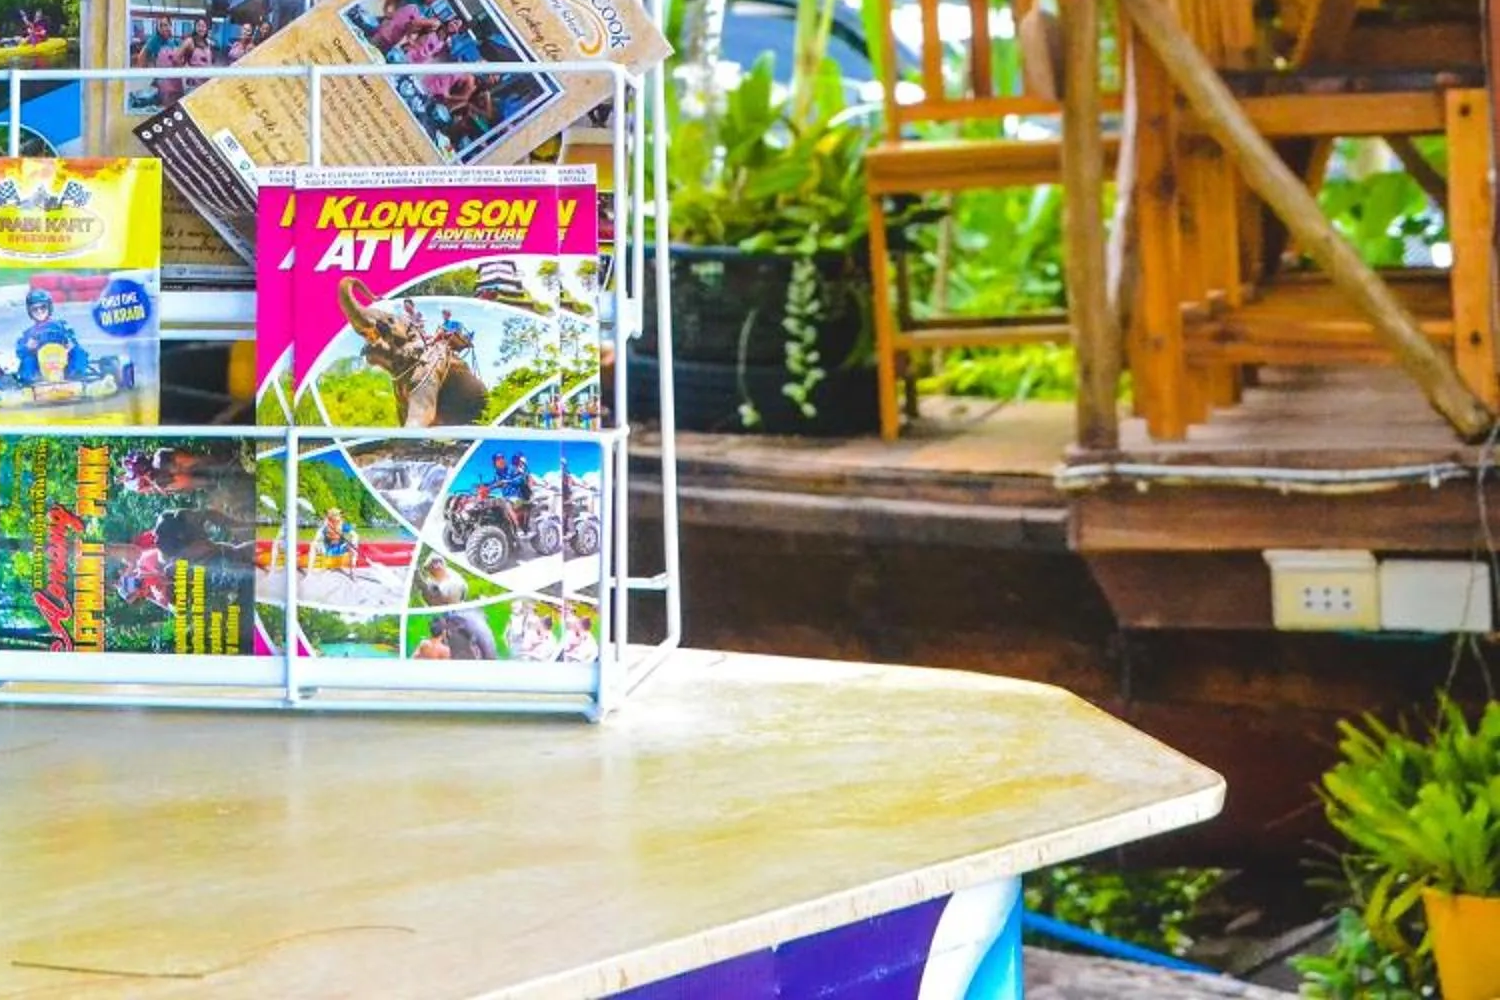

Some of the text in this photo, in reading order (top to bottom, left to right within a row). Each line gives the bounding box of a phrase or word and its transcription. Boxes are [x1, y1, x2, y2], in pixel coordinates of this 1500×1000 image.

[45, 217, 95, 233] KART
[316, 195, 538, 229] KLONG SON
[313, 228, 431, 273] ATV
[433, 227, 529, 241] ADVENTURE
[75, 446, 110, 653] LEPHANT PARK
[31, 504, 85, 652] Aonang
